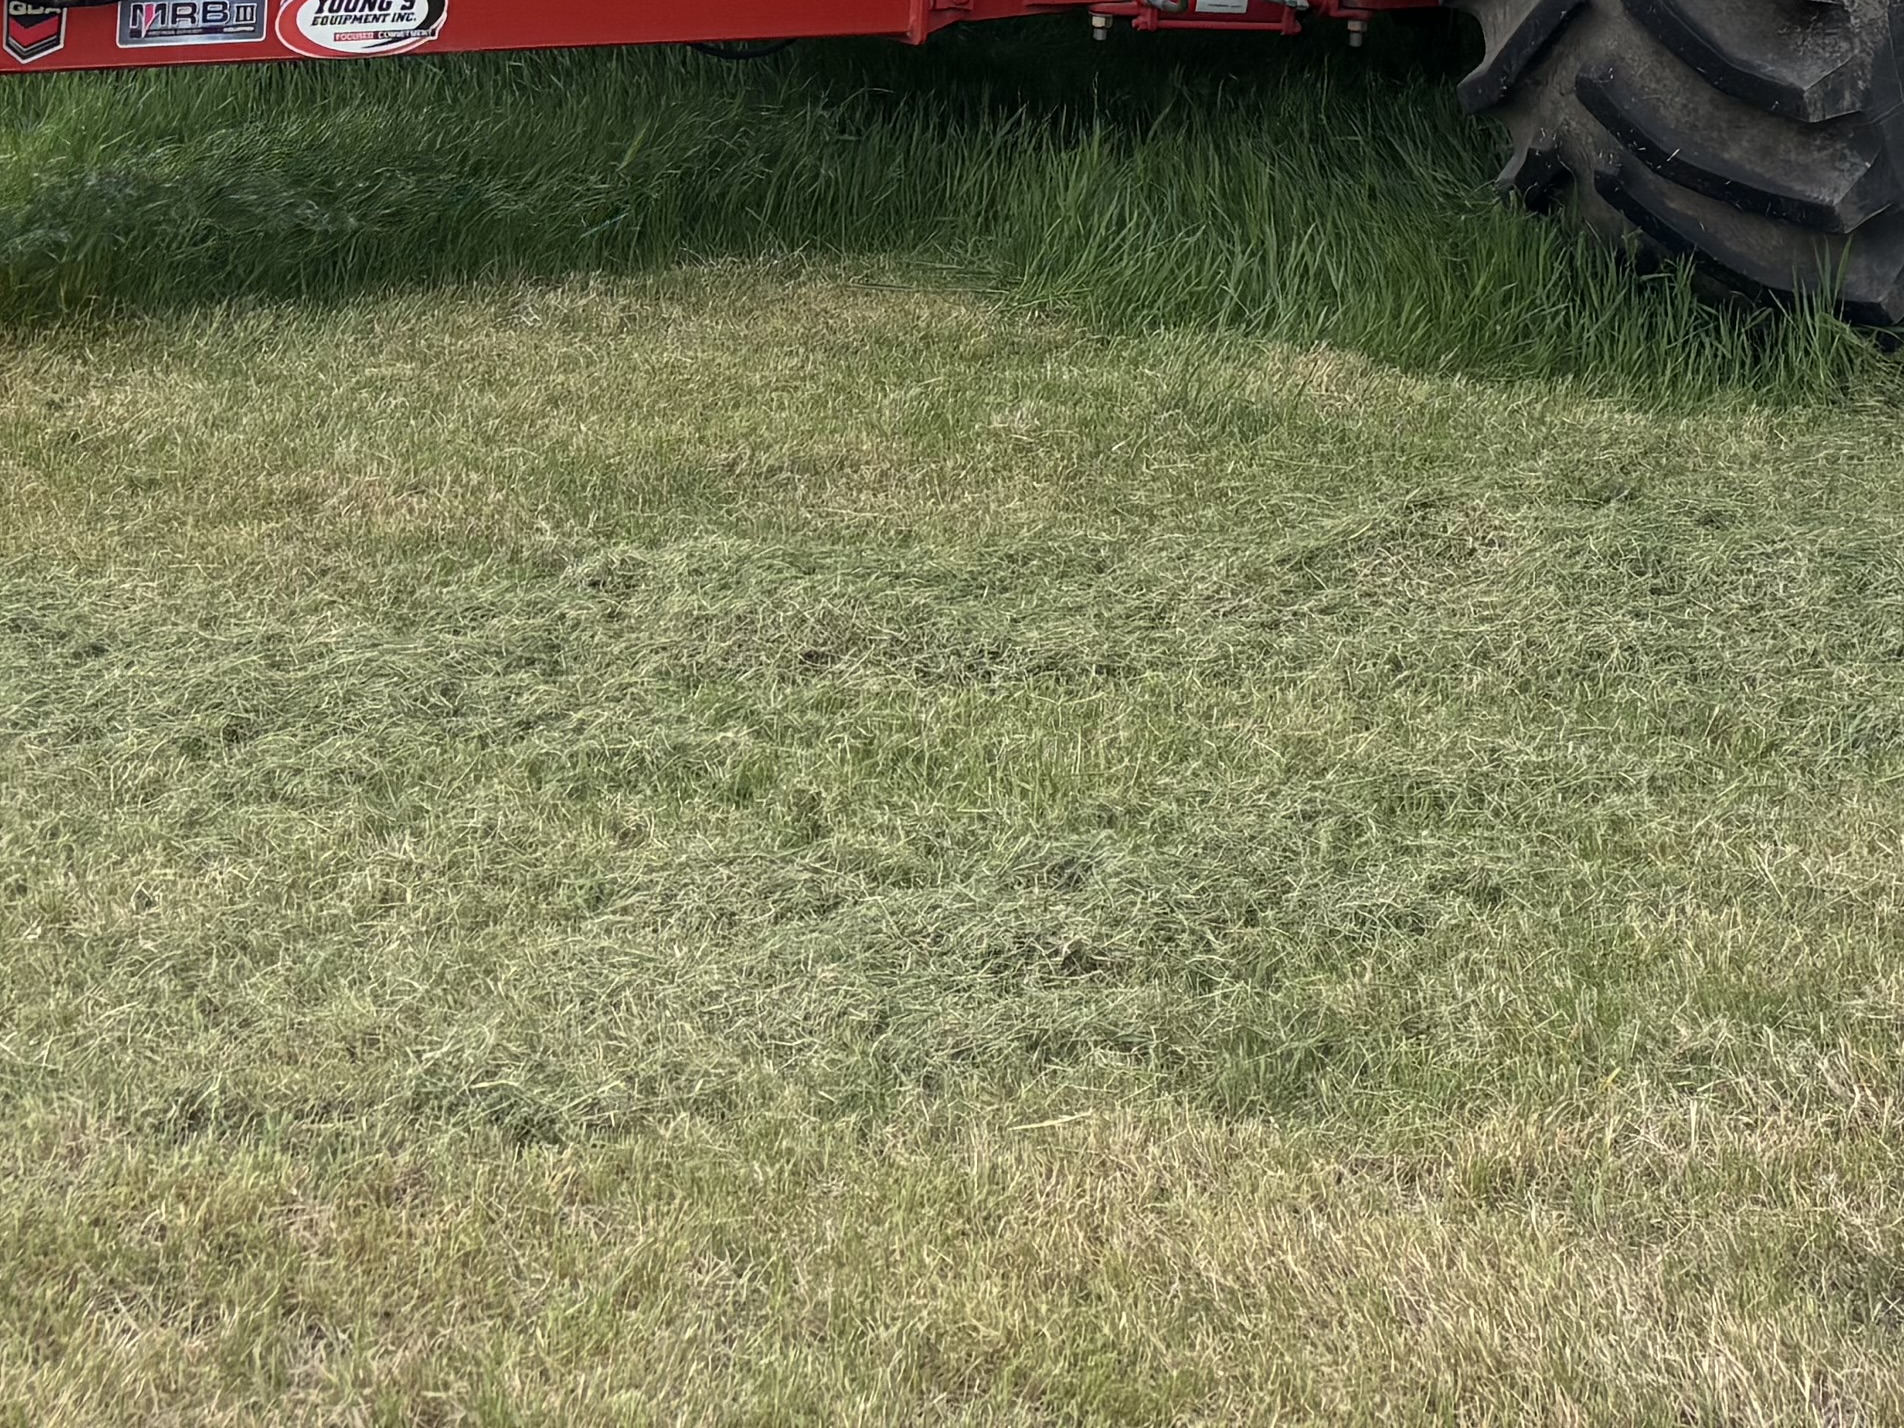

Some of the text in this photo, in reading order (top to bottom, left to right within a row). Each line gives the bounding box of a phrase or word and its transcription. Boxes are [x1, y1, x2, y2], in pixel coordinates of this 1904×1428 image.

[129, 0, 230, 30] MRB
[311, 12, 417, 26] EQUIPMENT INC.
